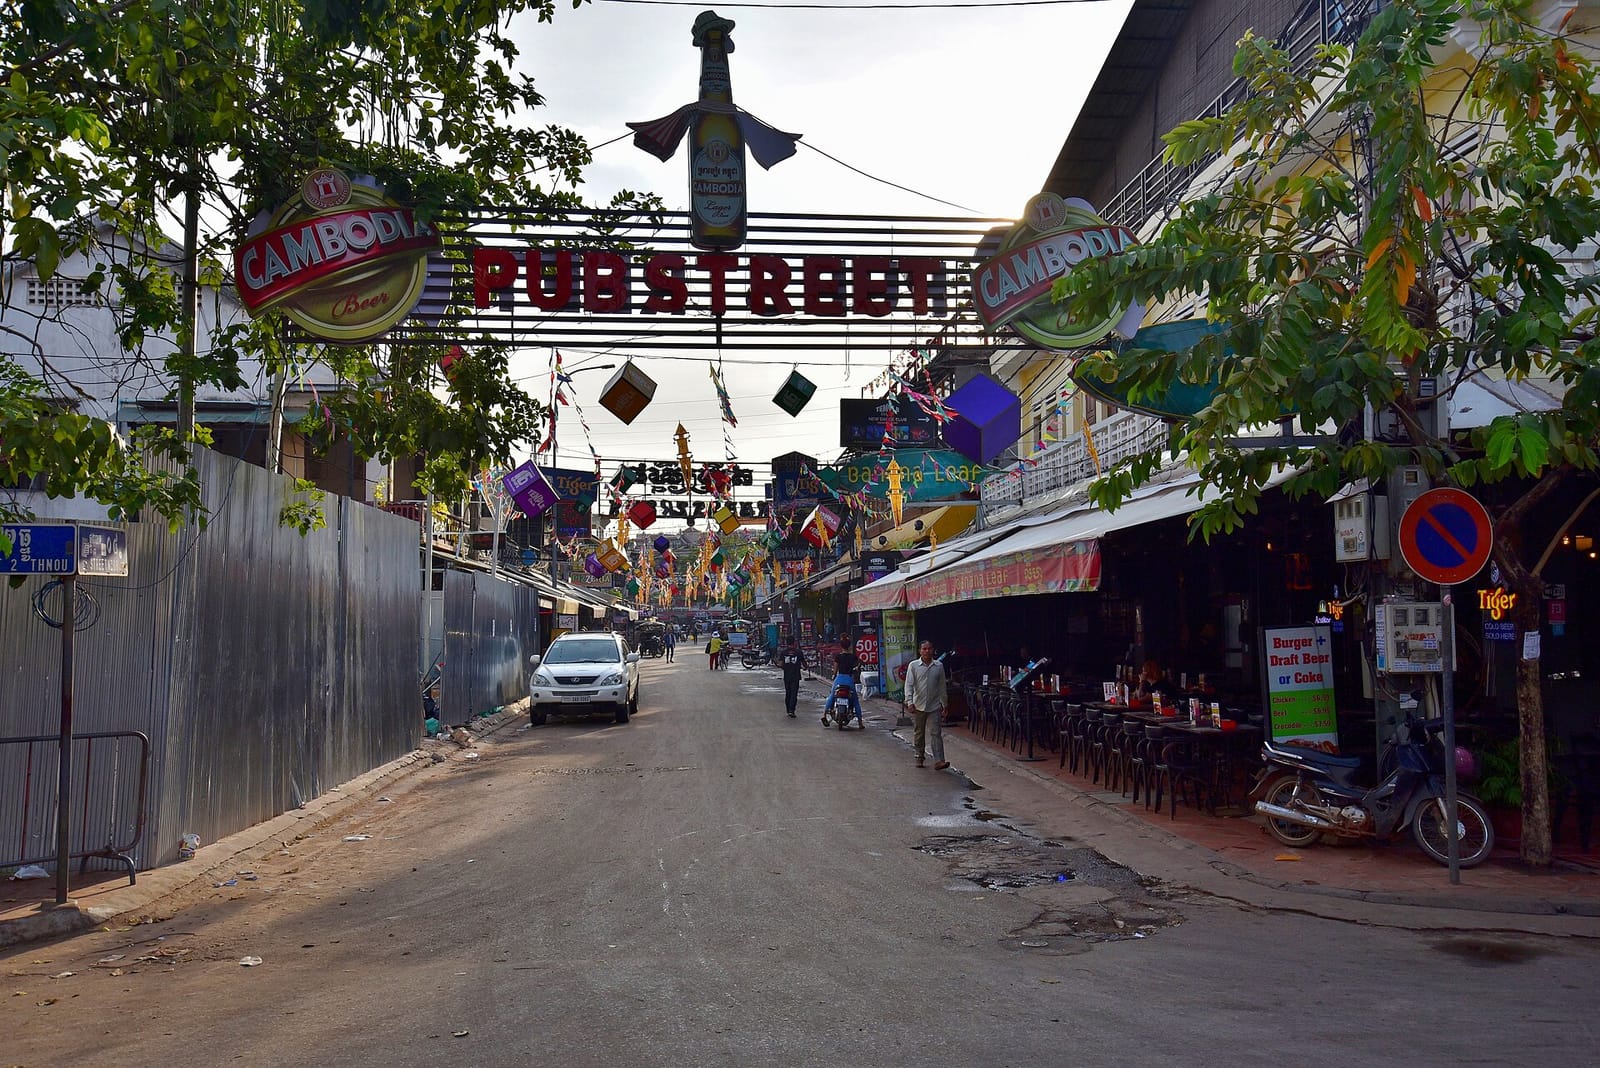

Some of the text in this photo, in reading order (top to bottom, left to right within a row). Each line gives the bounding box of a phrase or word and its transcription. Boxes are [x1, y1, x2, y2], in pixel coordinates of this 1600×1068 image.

[242, 210, 432, 290] CAMBODIA
[474, 247, 944, 316] PUB STREET
[331, 291, 390, 319] Beer
[847, 463, 981, 483] Bana Leaf
[557, 476, 593, 495] Tiger
[10, 559, 17, 571] 2
[31, 559, 68, 571] THNOU
[1477, 586, 1517, 621] Tiger
[1484, 622, 1499, 630] COLD
[1273, 637, 1313, 650] Burger
[1270, 653, 1330, 666] Draft Beer
[1279, 672, 1323, 685] or Coke
